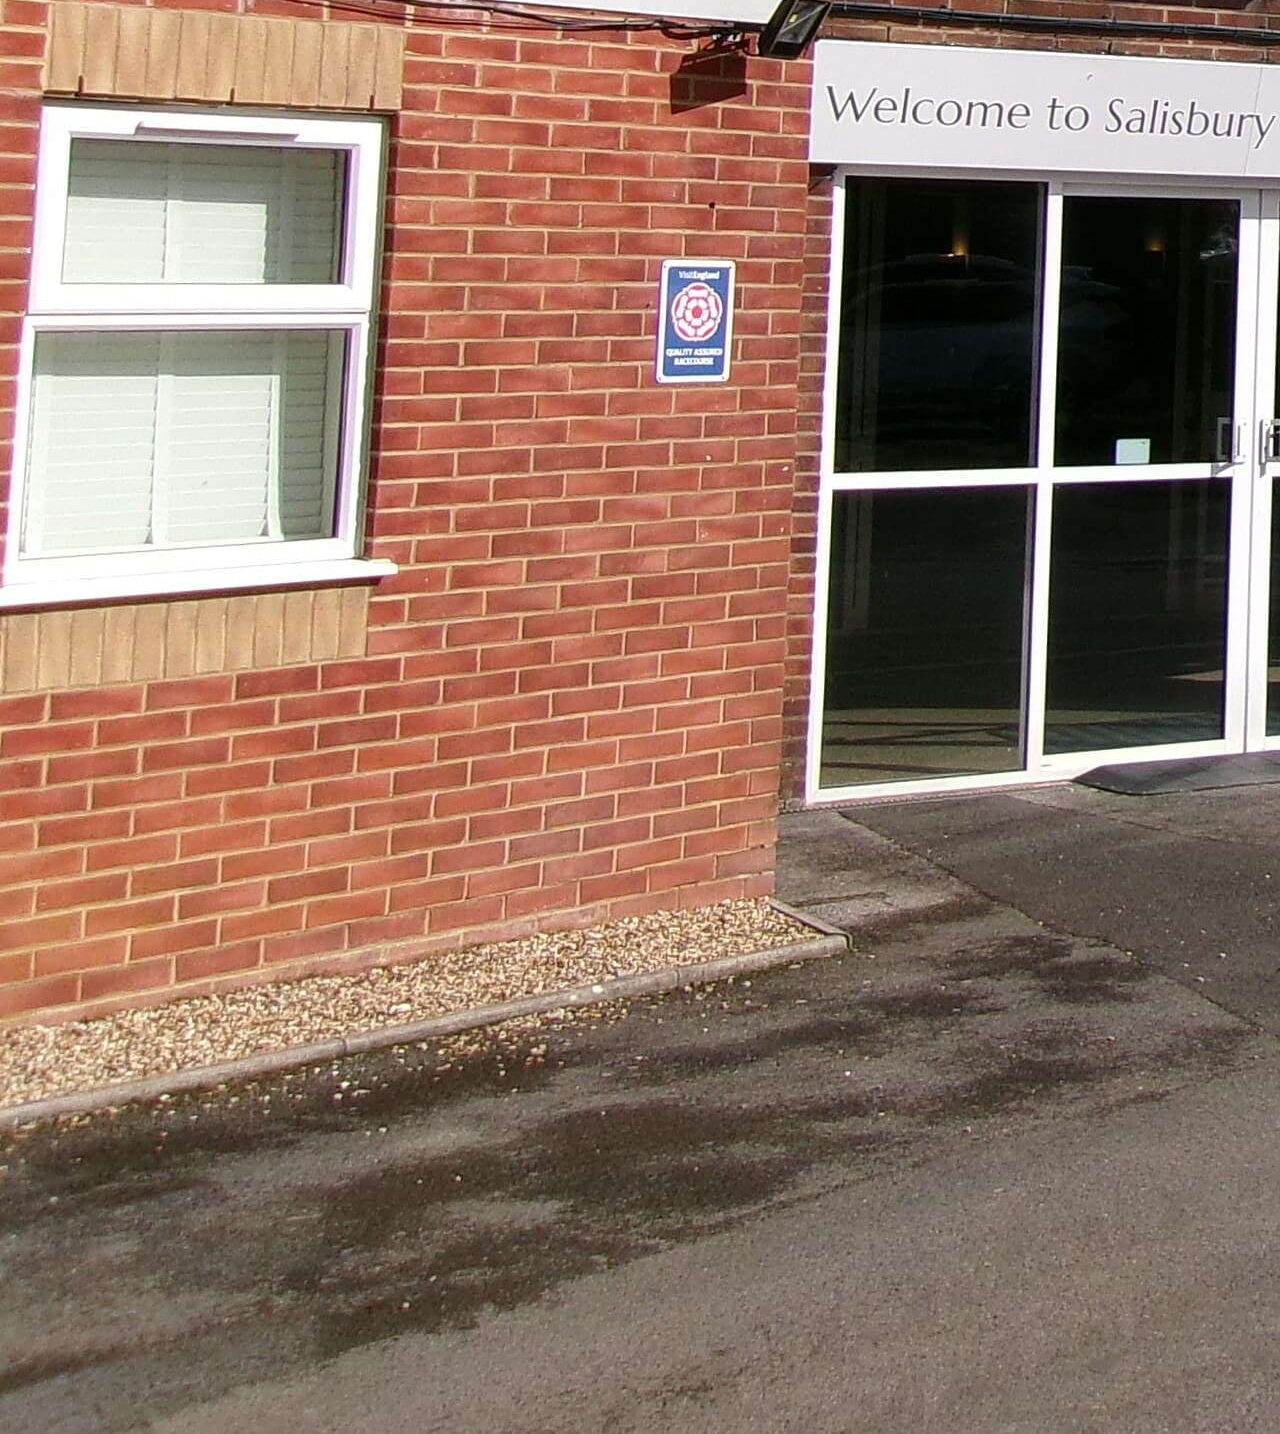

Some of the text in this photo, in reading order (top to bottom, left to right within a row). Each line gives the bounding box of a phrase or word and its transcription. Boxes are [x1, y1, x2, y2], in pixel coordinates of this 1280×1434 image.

[826, 84, 1032, 131] Welcome
[1045, 97, 1092, 132] to
[1103, 98, 1278, 150] Salisbury
